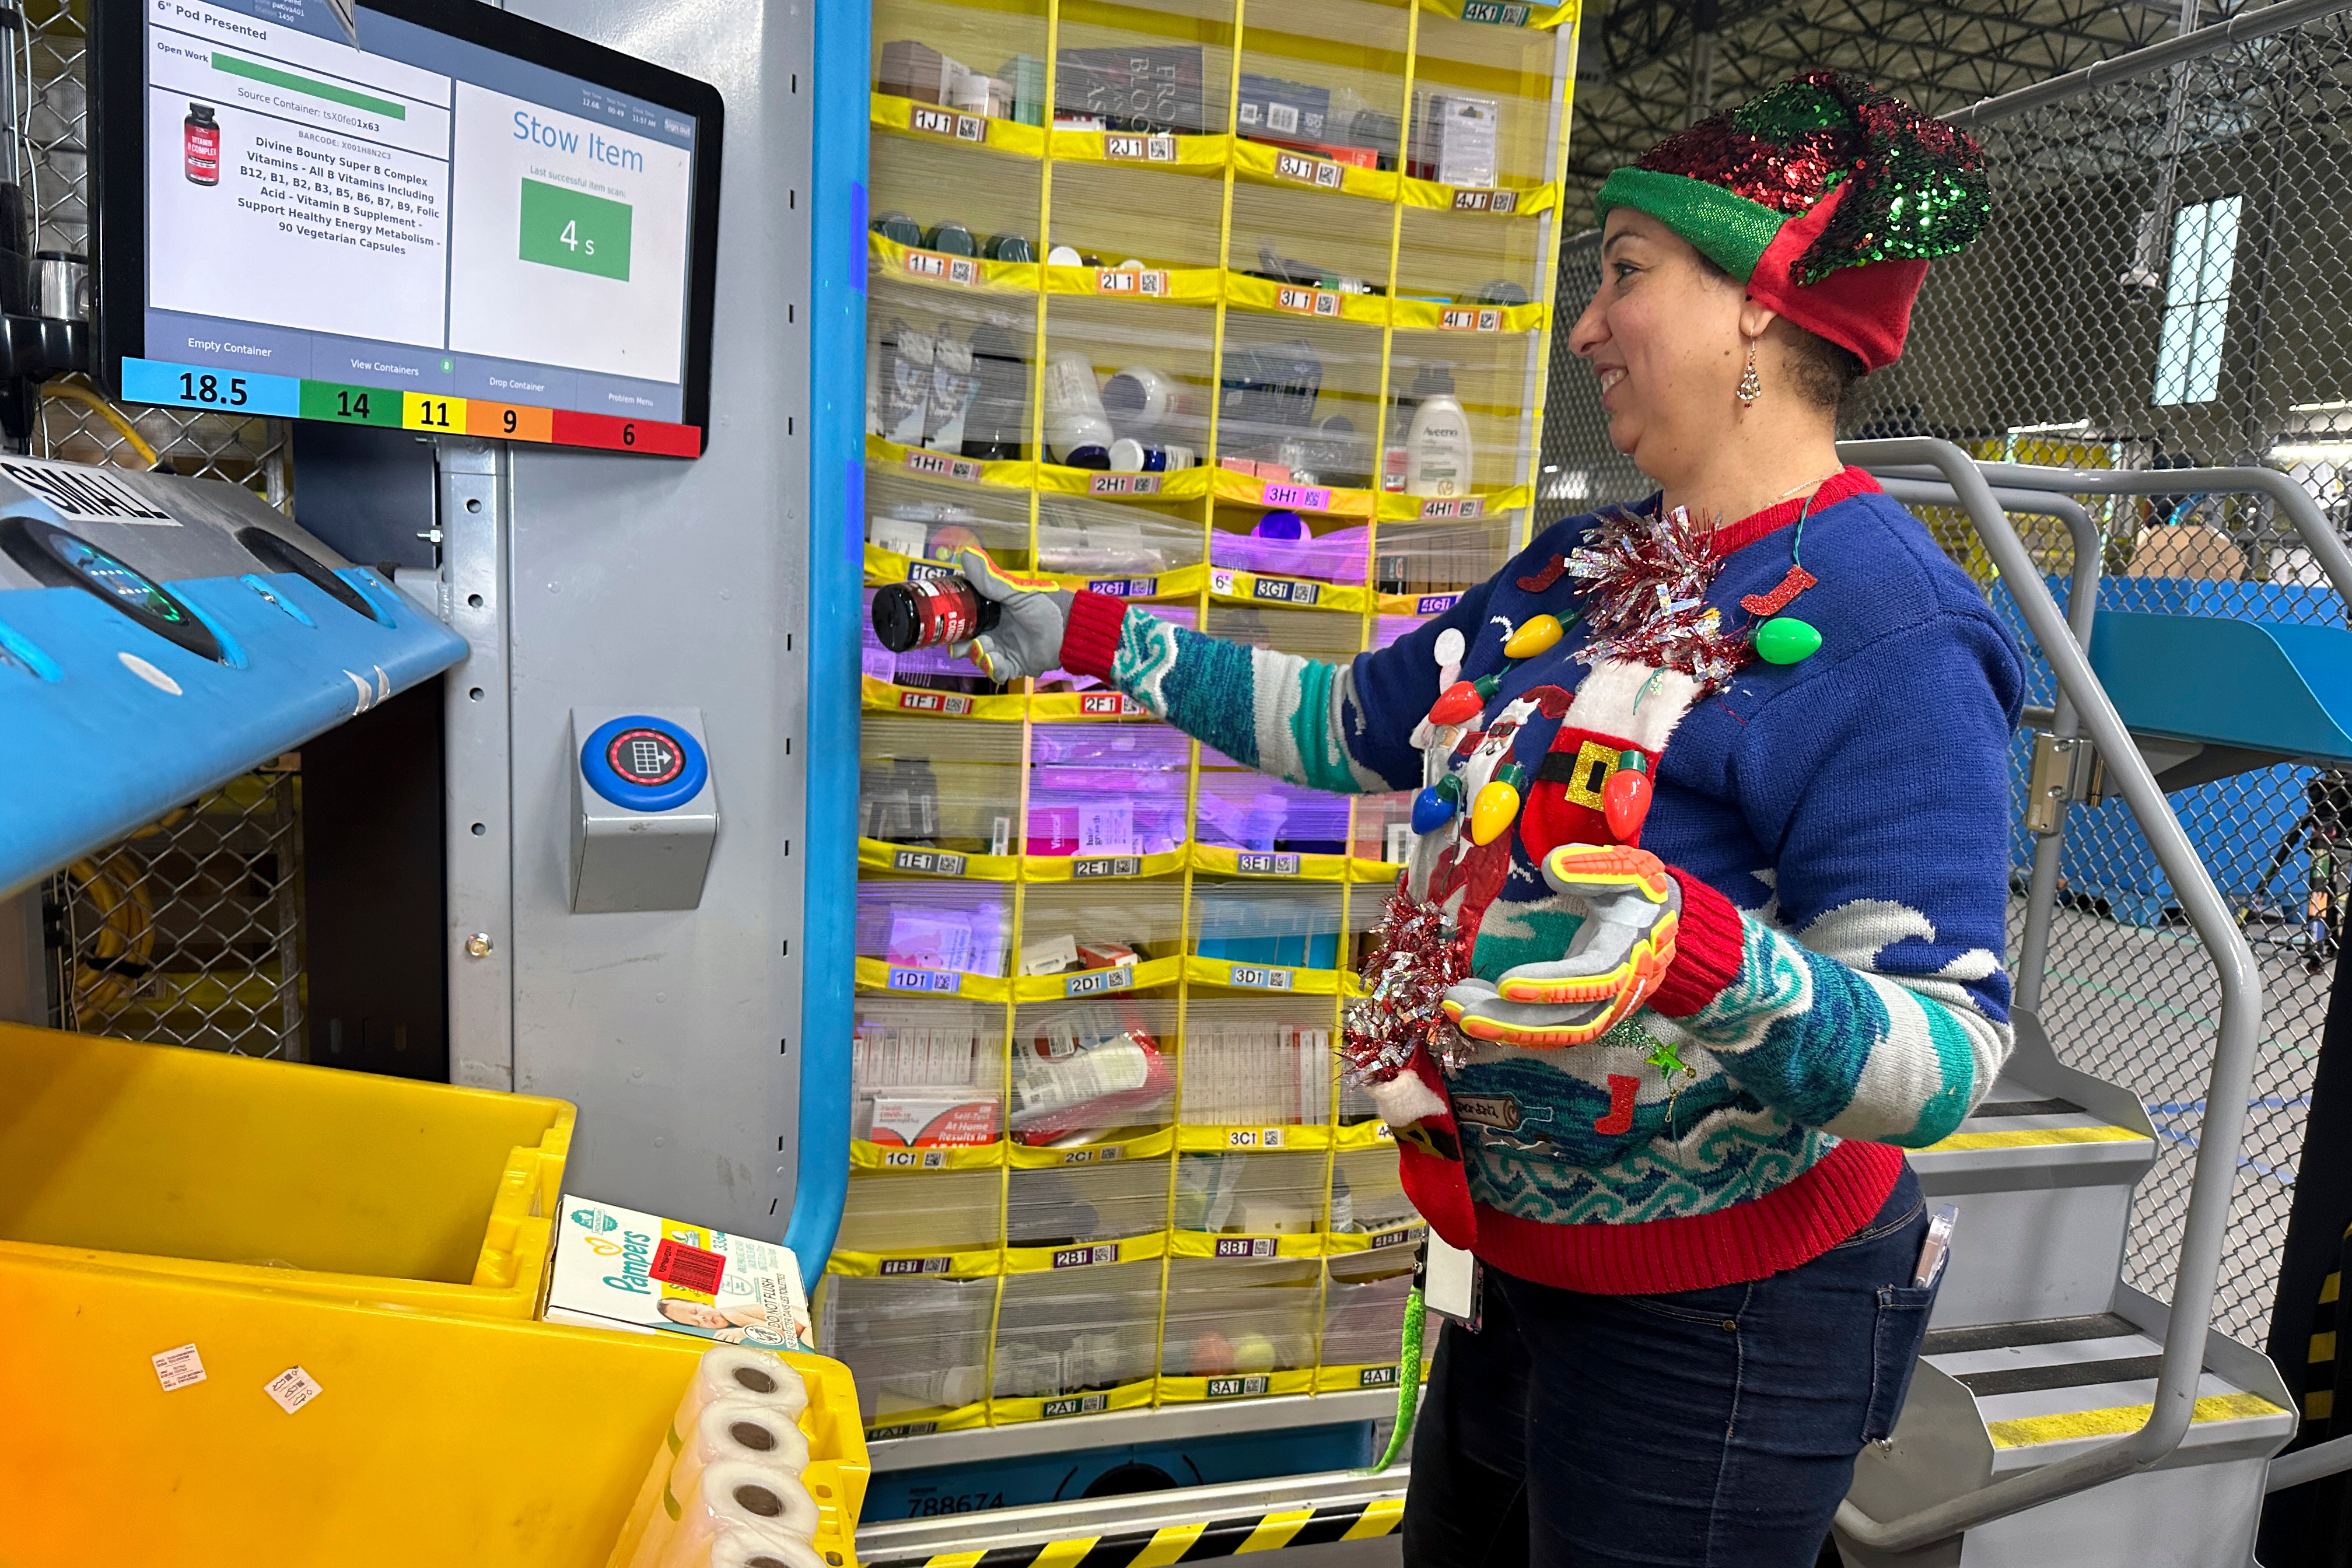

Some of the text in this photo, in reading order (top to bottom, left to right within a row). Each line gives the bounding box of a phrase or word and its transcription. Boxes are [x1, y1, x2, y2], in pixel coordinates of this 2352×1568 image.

[176, 5, 200, 20] Pod
[204, 14, 267, 40] Presented
[157, 42, 208, 62] Open Work
[238, 88, 271, 103] Source
[274, 97, 321, 117] Container:
[298, 131, 340, 147] BARCODE:
[664, 120, 679, 134] Sign
[191, 135, 213, 147] VITAMIN
[191, 145, 216, 156] COMPLEX
[513, 111, 643, 173] Stow Item
[256, 136, 428, 187] Divine Bounty Super B Complex
[247, 150, 299, 171] Vitamins
[309, 166, 324, 177] All
[327, 170, 335, 180] B
[338, 172, 384, 191] Vitamins
[388, 184, 434, 204] Including
[530, 164, 547, 178] Last
[548, 170, 587, 190] successful
[589, 179, 606, 193] item
[240, 166, 440, 219] B12, B1, B2, B3, B5, B6, B7, B9, Folic
[260, 186, 285, 200] Acid
[296, 194, 340, 212] Vitamin
[342, 205, 350, 214] B
[353, 206, 416, 228] Supplement
[238, 197, 285, 216] Support
[288, 208, 332, 226] Healthy
[335, 218, 373, 235] Energy
[375, 228, 434, 246] Metabolism
[278, 222, 406, 256] 90 Vegetarian Capsules
[559, 219, 595, 256] 4 s
[188, 338, 272, 358] Empty Container
[351, 359, 450, 376] View Containers 8
[180, 372, 248, 405] 18.5
[489, 377, 545, 392] Drop Container
[337, 391, 370, 419] 14
[421, 400, 450, 426] 11
[608, 393, 654, 407] Problem Menu
[503, 410, 517, 433] 9
[623, 424, 635, 445] 6
[938, 1132, 987, 1142] Results in
[945, 1121, 989, 1131] At Home
[602, 1230, 651, 1295] Pampers
[776, 1273, 788, 1296] TOILETTES
[761, 1277, 780, 1328] DO NOT FLUSH
[780, 1295, 790, 1304] LES
[782, 1304, 792, 1318] DANS
[908, 1492, 1005, 1518] 788674
